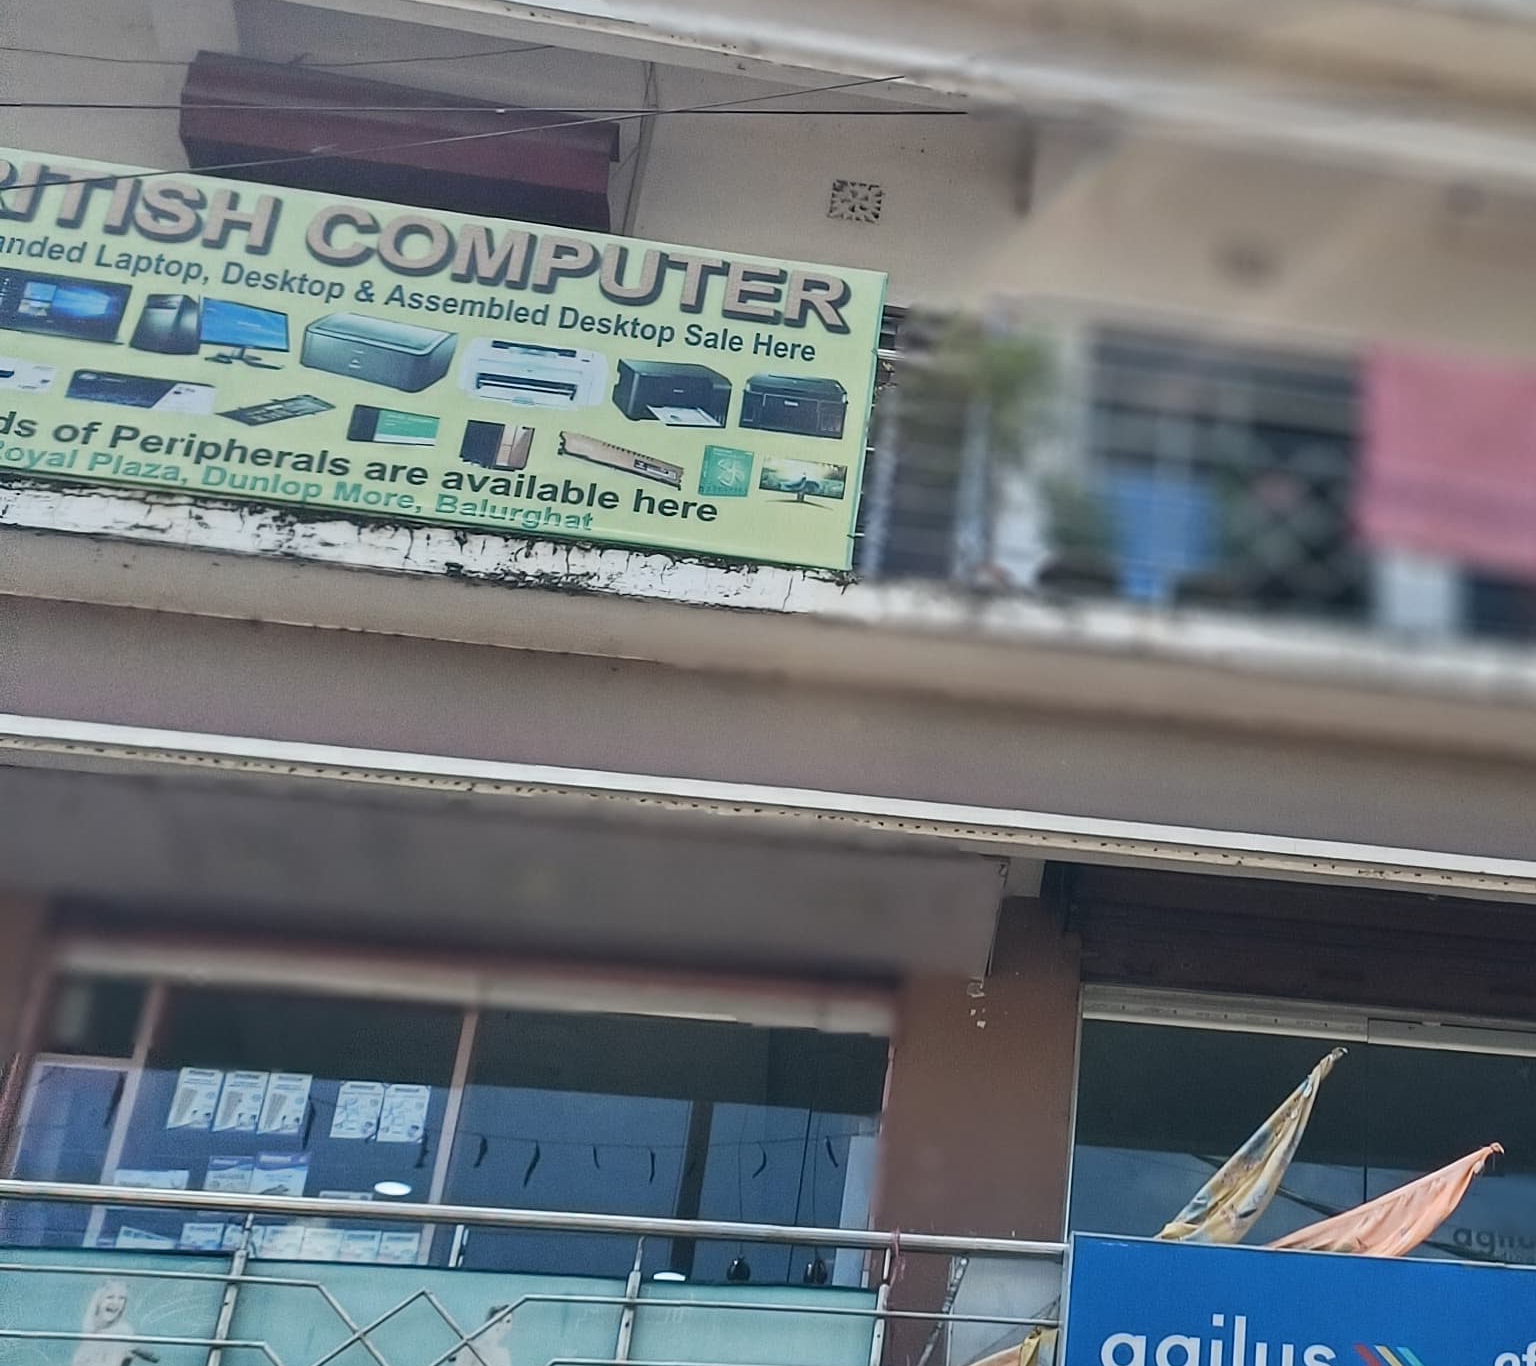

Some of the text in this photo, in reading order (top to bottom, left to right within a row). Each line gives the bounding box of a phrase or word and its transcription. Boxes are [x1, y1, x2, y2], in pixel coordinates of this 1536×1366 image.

[0, 159, 851, 334] ITISH COMPUTER
[99, 244, 209, 285] Laptop,
[222, 261, 344, 304] Desktop
[354, 280, 375, 303] &
[384, 284, 549, 327] Assembled
[558, 305, 675, 347] Desktop
[684, 324, 744, 352] Sale
[752, 333, 816, 362] Here
[53, 421, 101, 445] of
[109, 425, 351, 477] Peripherals
[364, 461, 429, 486] are
[441, 469, 620, 510] available
[632, 488, 719, 523] here
[87, 450, 189, 485] Plaza,
[202, 464, 323, 504] Dunlop
[333, 481, 422, 514] More,
[435, 493, 594, 532] Balurghat
